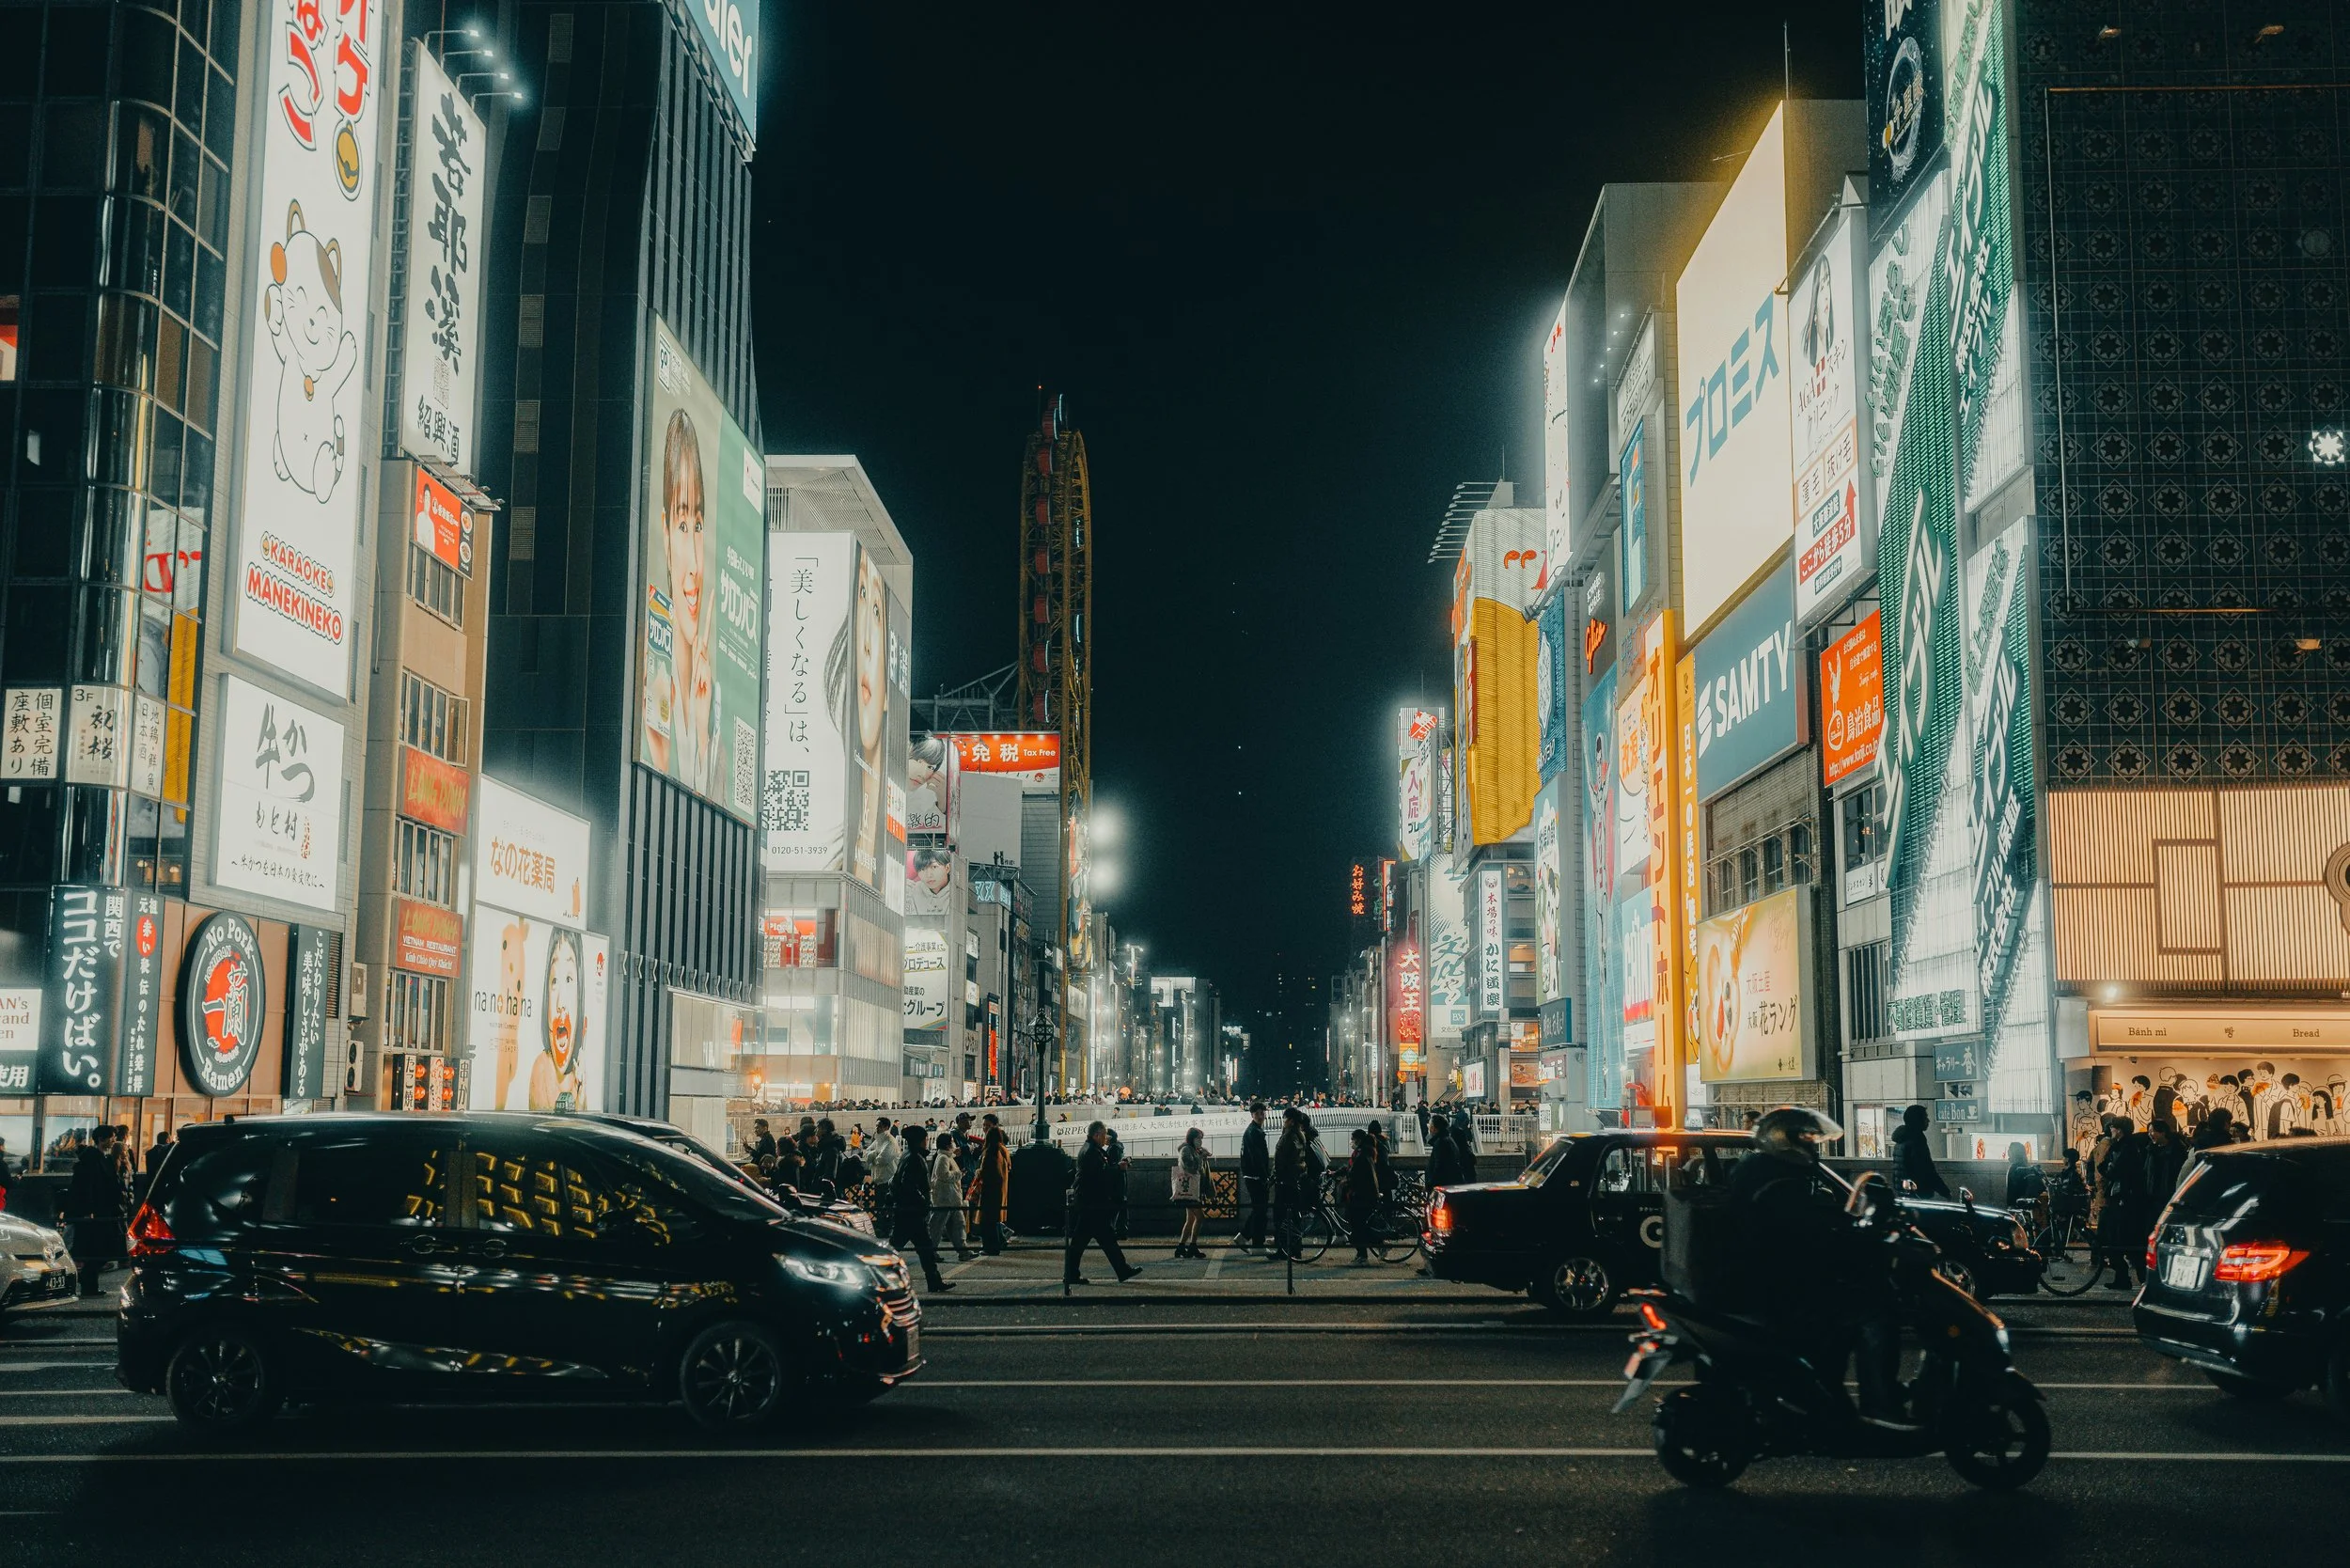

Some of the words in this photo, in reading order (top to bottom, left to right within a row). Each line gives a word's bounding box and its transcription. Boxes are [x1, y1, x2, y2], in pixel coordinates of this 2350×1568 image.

[1944, 80, 1993, 349] エイブル
[1956, 237, 1990, 373] 株式会社
[1686, 290, 1779, 488] プロミス
[1959, 290, 1992, 425] エイブル
[1807, 383, 1840, 438] クリニック
[270, 540, 327, 590] KARAOKE
[247, 567, 342, 640] MANEKINEKO
[74, 688, 95, 702] 3F
[1716, 619, 1792, 739] SAMTY
[1876, 487, 1947, 887] エイブル
[9, 691, 31, 775] 座敷あり
[30, 692, 54, 776] 個室完備
[971, 743, 1019, 762] 免税
[1023, 748, 1036, 757] Tax
[1039, 748, 1056, 757] Free
[1973, 649, 2018, 904] エイブル
[491, 835, 556, 894] なの花薬局
[772, 846, 828, 855] 0120-51-3939
[138, 898, 159, 915] 元祖
[1351, 864, 1366, 916] お好み焼
[1485, 893, 1498, 938] 本場の味
[103, 895, 125, 959] 関西で
[206, 925, 225, 954] No
[227, 917, 255, 960] Pork
[402, 934, 424, 949] VIETNAM
[426, 939, 457, 954] RESTAURANT
[1981, 872, 2018, 998] 株式会社
[62, 890, 102, 1088] ココだけばい。
[202, 961, 249, 1046] 一蘭
[310, 931, 324, 1045] こだわりたい
[1397, 949, 1420, 1012] 大阪王
[1485, 943, 1501, 1006] かに道楽
[297, 951, 313, 1096] 美味しさがある
[2127, 1027, 2153, 1037] Bánh
[2154, 1026, 2168, 1037] mì
[2292, 1028, 2321, 1038] Bread
[201, 1058, 244, 1091] Ramen
[404, 1056, 415, 1111] たこ焼
[1937, 1105, 1950, 1121] café
[1950, 1103, 1966, 1120] Bon
